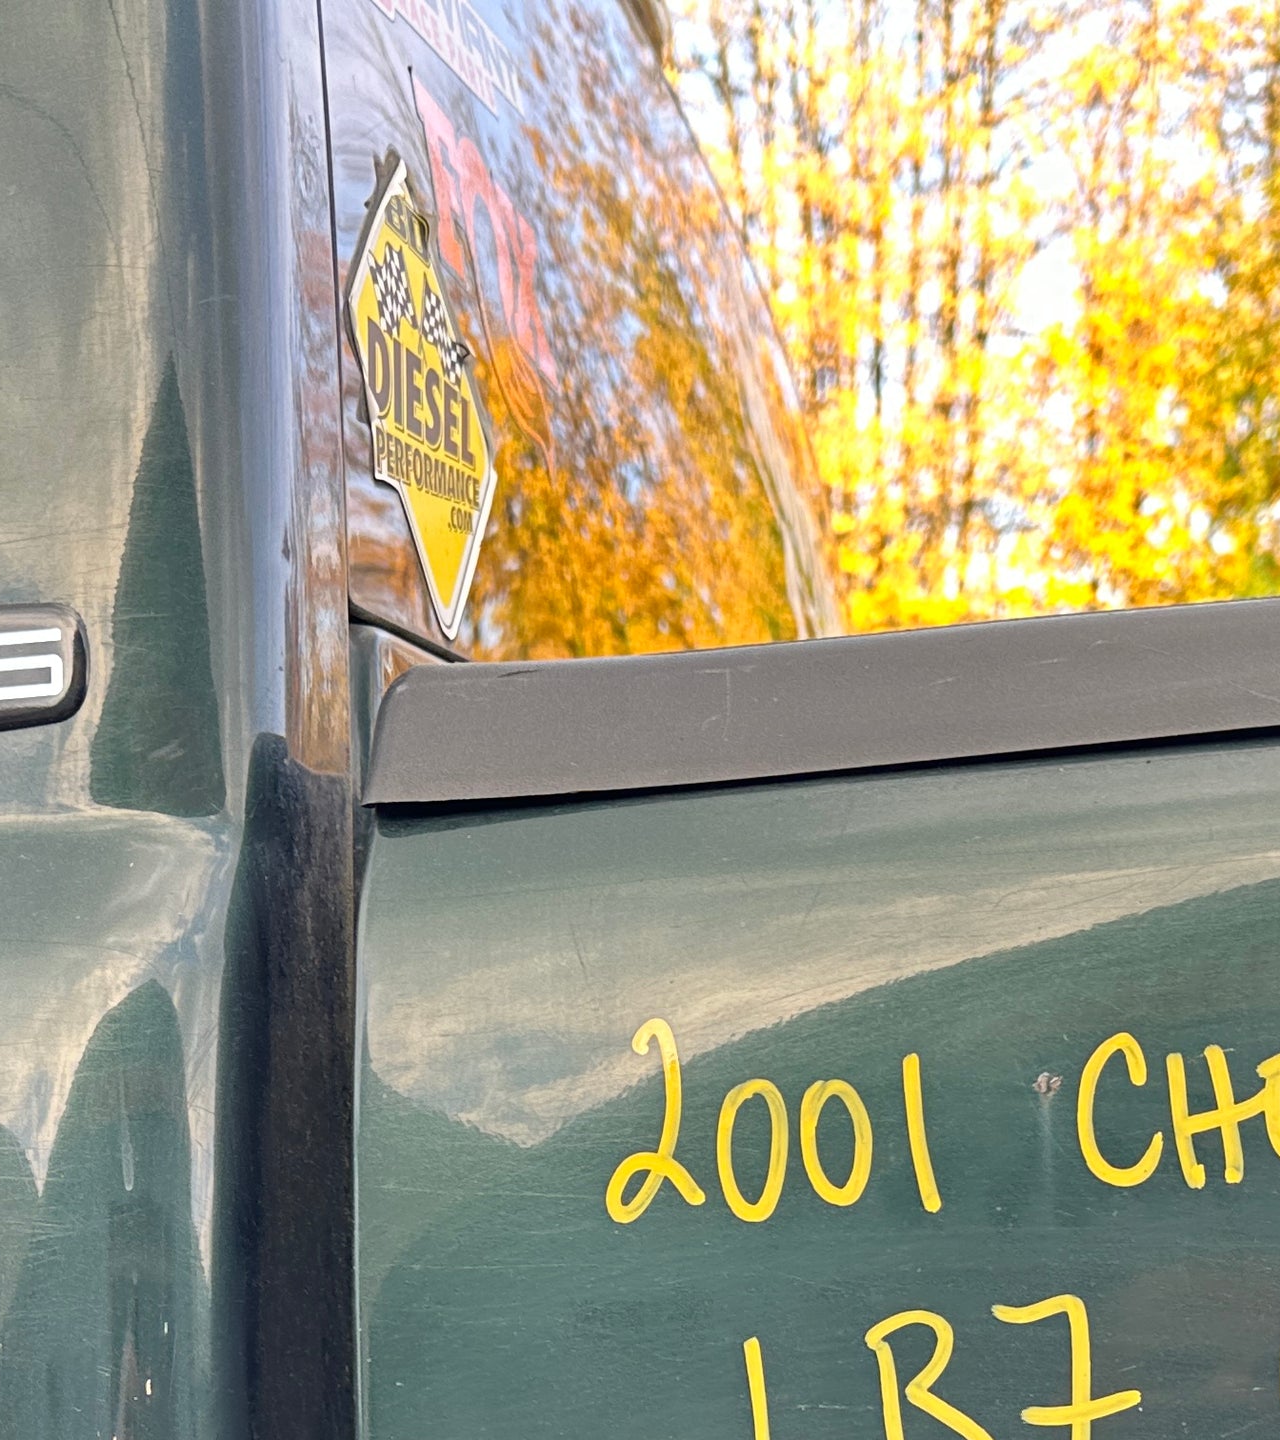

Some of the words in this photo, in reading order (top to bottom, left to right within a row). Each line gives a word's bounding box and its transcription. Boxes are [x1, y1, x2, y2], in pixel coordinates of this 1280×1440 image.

[384, 194, 429, 269] BD
[367, 316, 475, 470] DIESEL
[375, 423, 480, 511] PERFORMANCE
[605, 1018, 942, 1224] 2001
